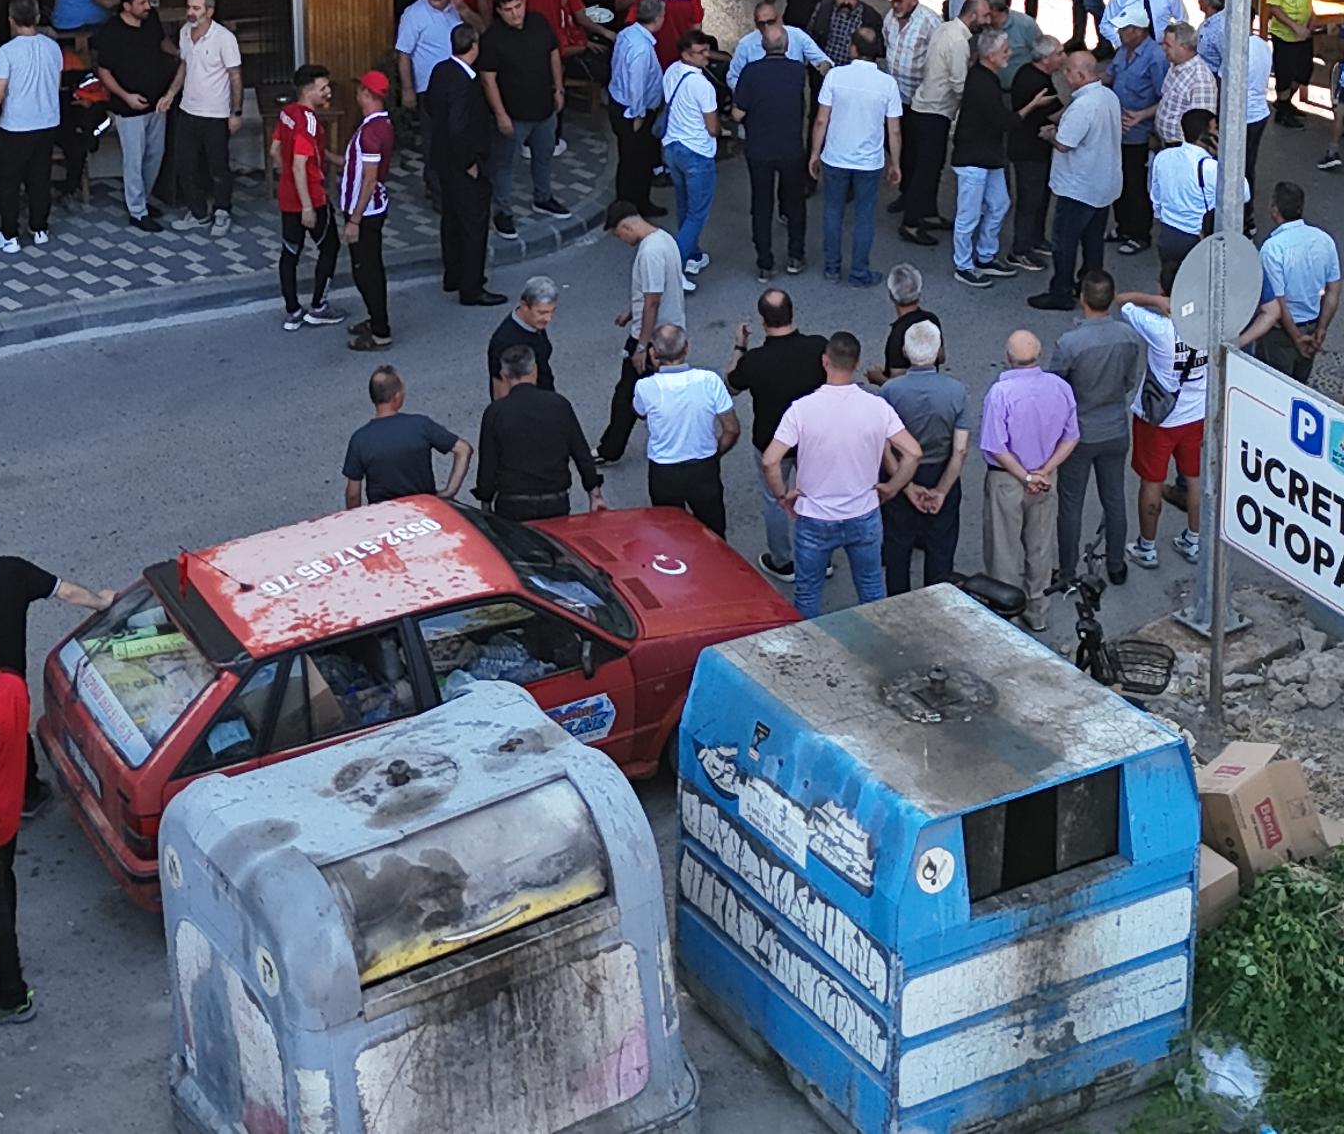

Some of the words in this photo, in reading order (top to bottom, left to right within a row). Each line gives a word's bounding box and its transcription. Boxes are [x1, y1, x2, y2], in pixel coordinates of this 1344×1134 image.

[1298, 408, 1317, 443] P
[376, 518, 442, 546] 0532
[334, 540, 383, 567] 517
[296, 559, 333, 582] 95
[260, 574, 301, 597] 76
